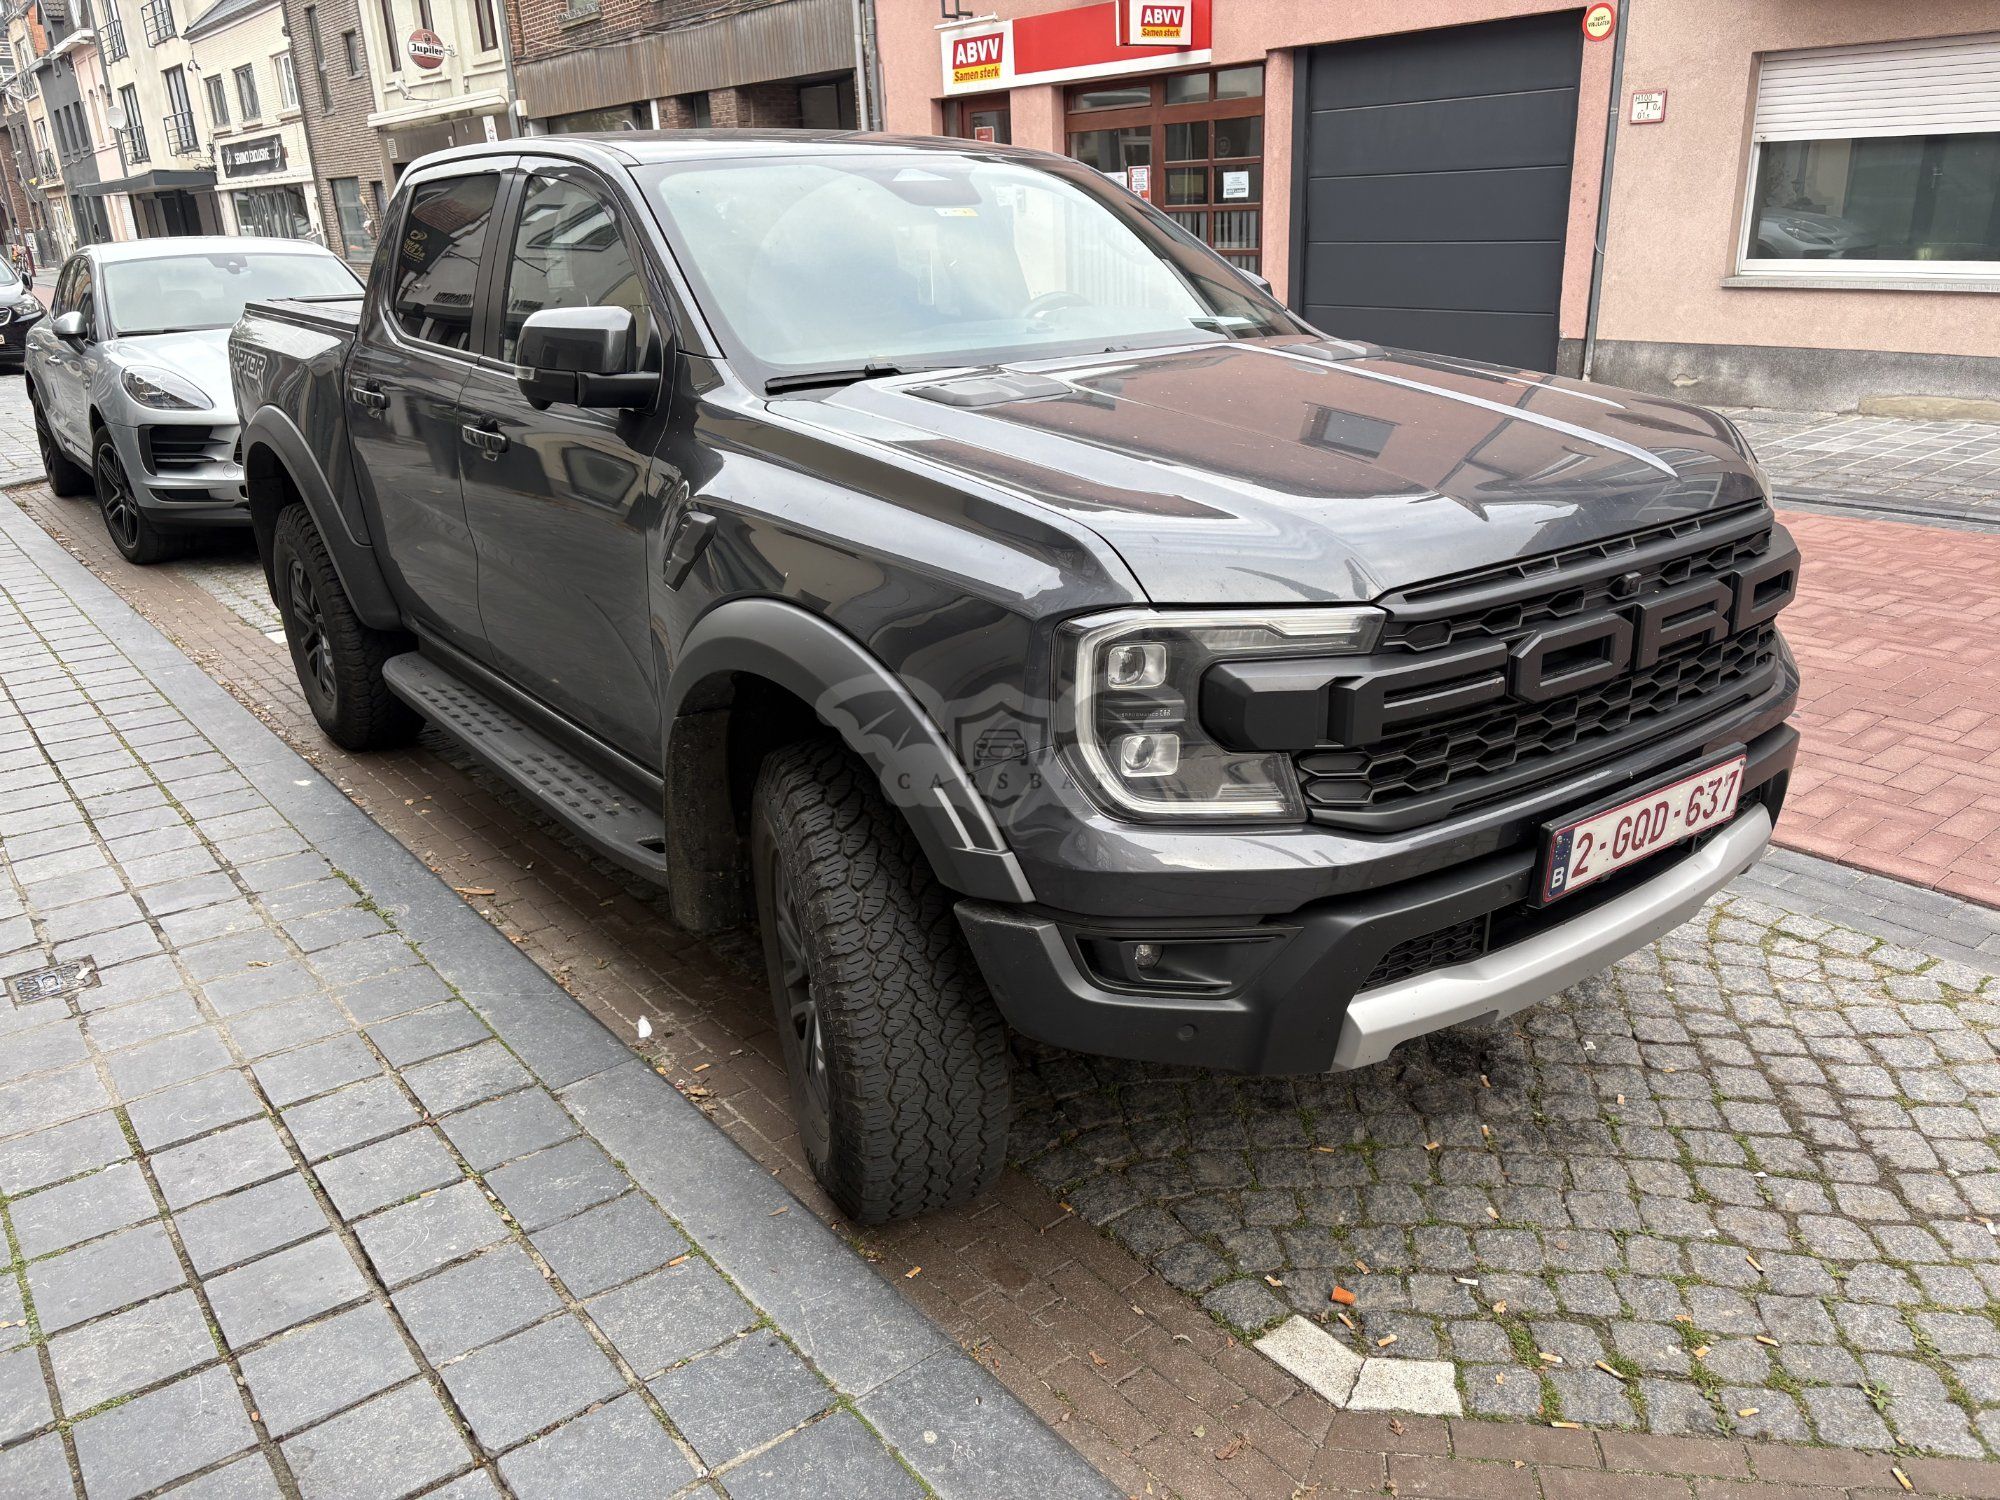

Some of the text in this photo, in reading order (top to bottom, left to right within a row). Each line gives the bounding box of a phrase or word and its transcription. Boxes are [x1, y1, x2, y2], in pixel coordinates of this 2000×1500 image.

[1143, 8, 1181, 25] ABVV
[1142, 28, 1180, 37] Samen sterk
[411, 43, 444, 56] Jupiler
[956, 37, 1000, 65] ABVV
[954, 66, 1000, 82] Samen sterk
[1332, 546, 1800, 748] FORD
[1571, 769, 1740, 879] 2-GQD-637
[1551, 866, 1565, 890] B
